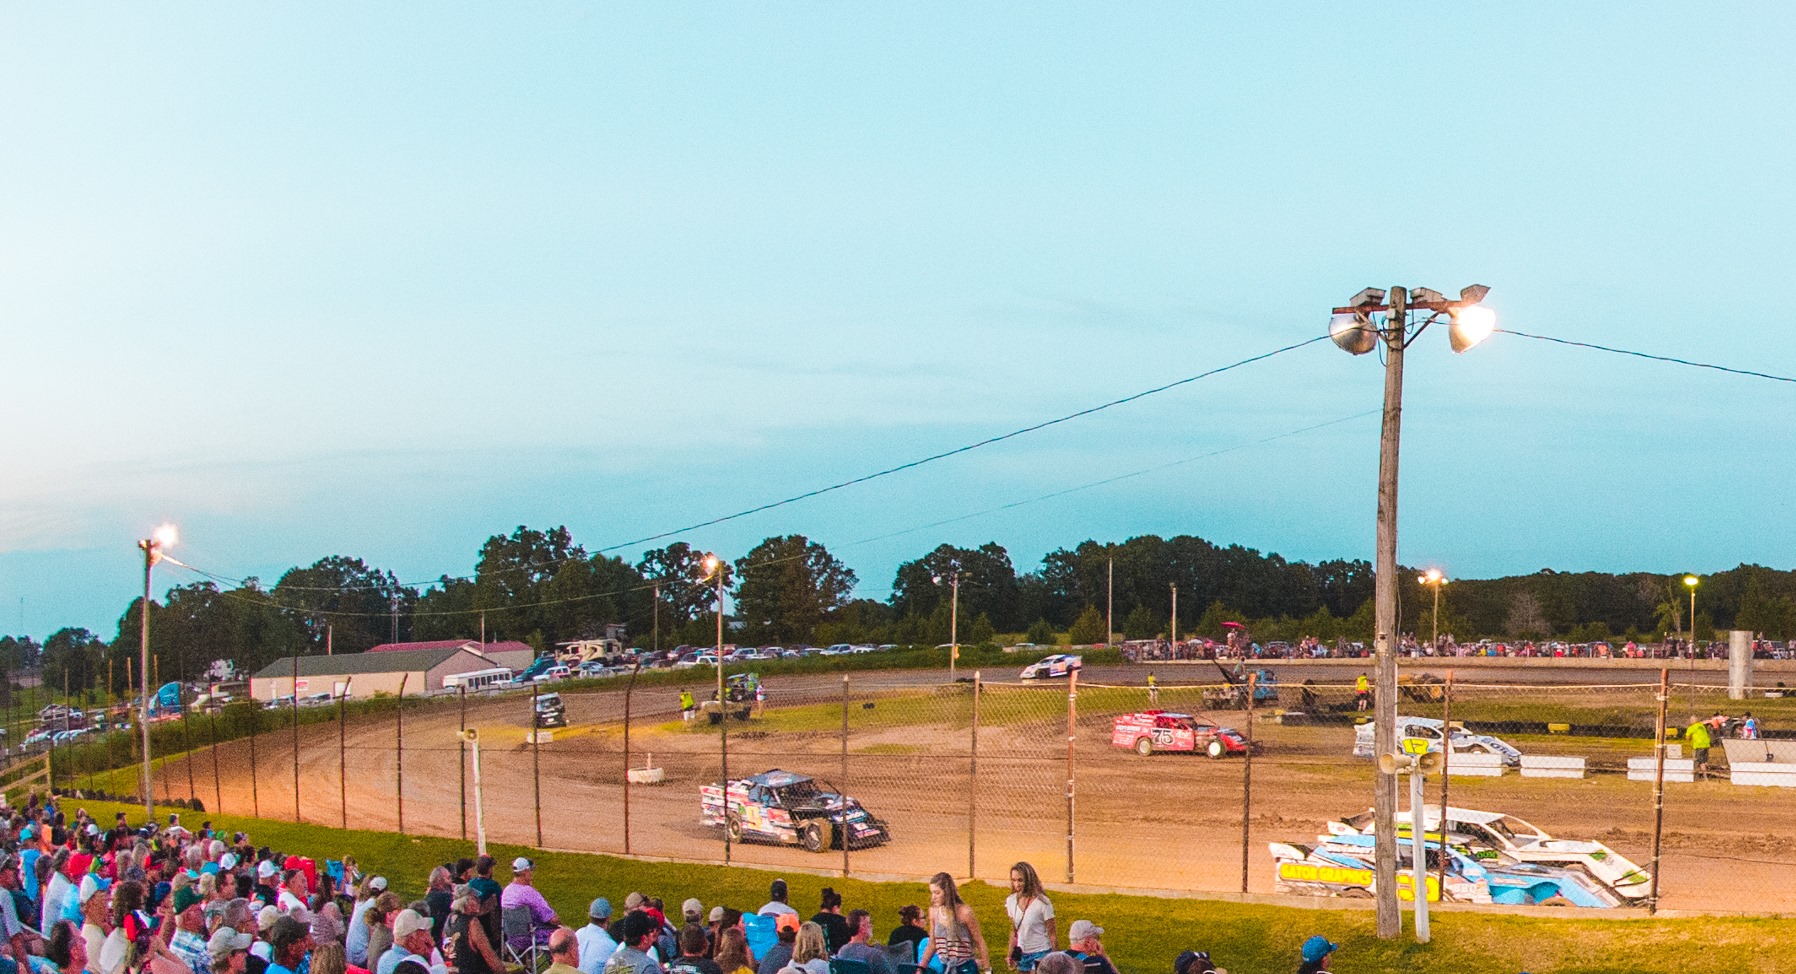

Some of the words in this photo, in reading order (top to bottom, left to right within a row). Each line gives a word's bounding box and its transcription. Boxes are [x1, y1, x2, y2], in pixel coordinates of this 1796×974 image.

[1151, 728, 1175, 745] 75
[1280, 862, 1319, 881] GATOR
[1318, 866, 1373, 886] GRAPHICS
